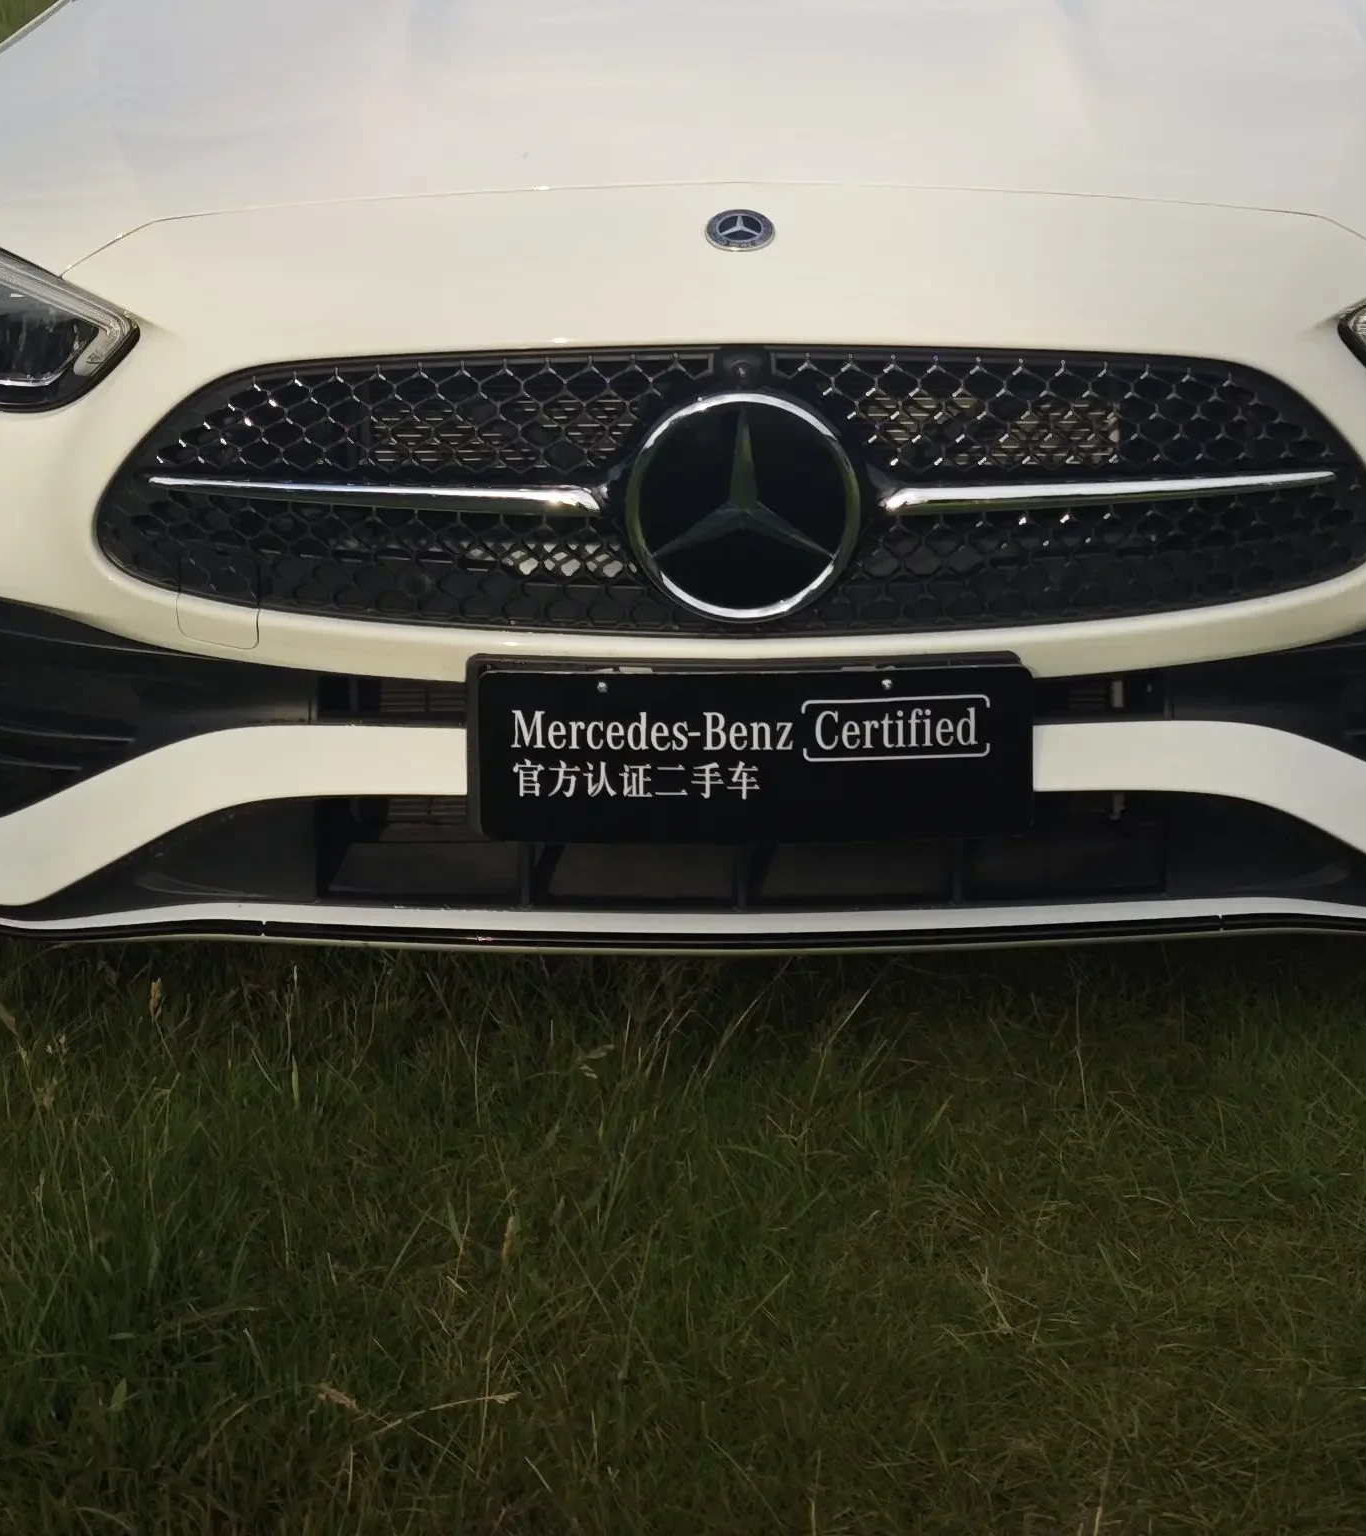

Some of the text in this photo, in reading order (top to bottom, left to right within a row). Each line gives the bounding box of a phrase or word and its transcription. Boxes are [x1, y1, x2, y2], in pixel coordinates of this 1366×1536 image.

[511, 707, 977, 751] Mercedes-Benz Certified
[513, 759, 759, 799] 官方认证二手车
